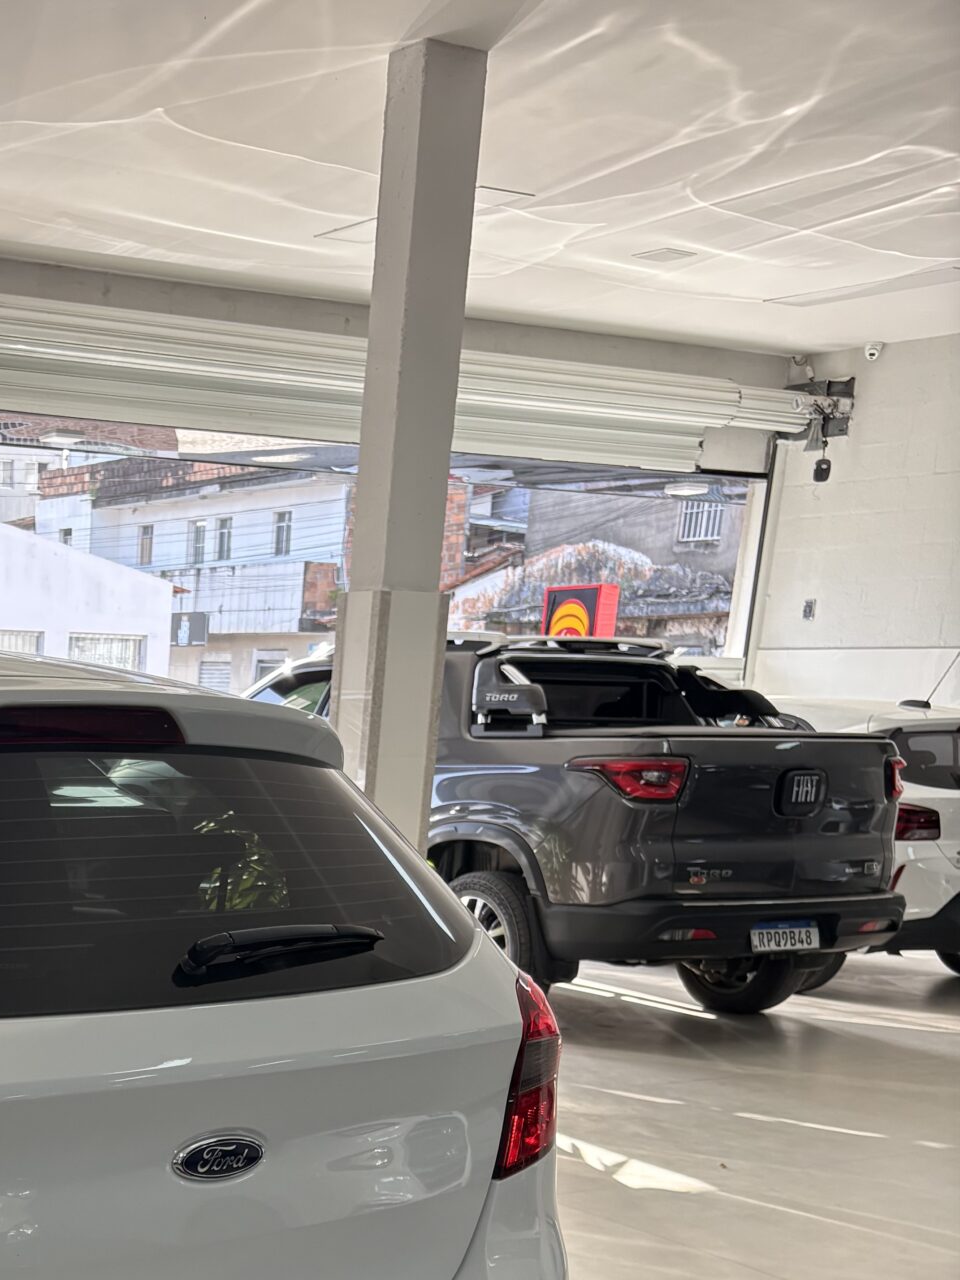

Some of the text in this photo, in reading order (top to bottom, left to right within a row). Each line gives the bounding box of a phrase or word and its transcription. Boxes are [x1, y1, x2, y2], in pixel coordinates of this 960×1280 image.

[485, 693, 519, 702] TORO
[791, 775, 820, 803] FIAT
[758, 929, 813, 949] RPQ9B48
[197, 1144, 249, 1173] Ford
